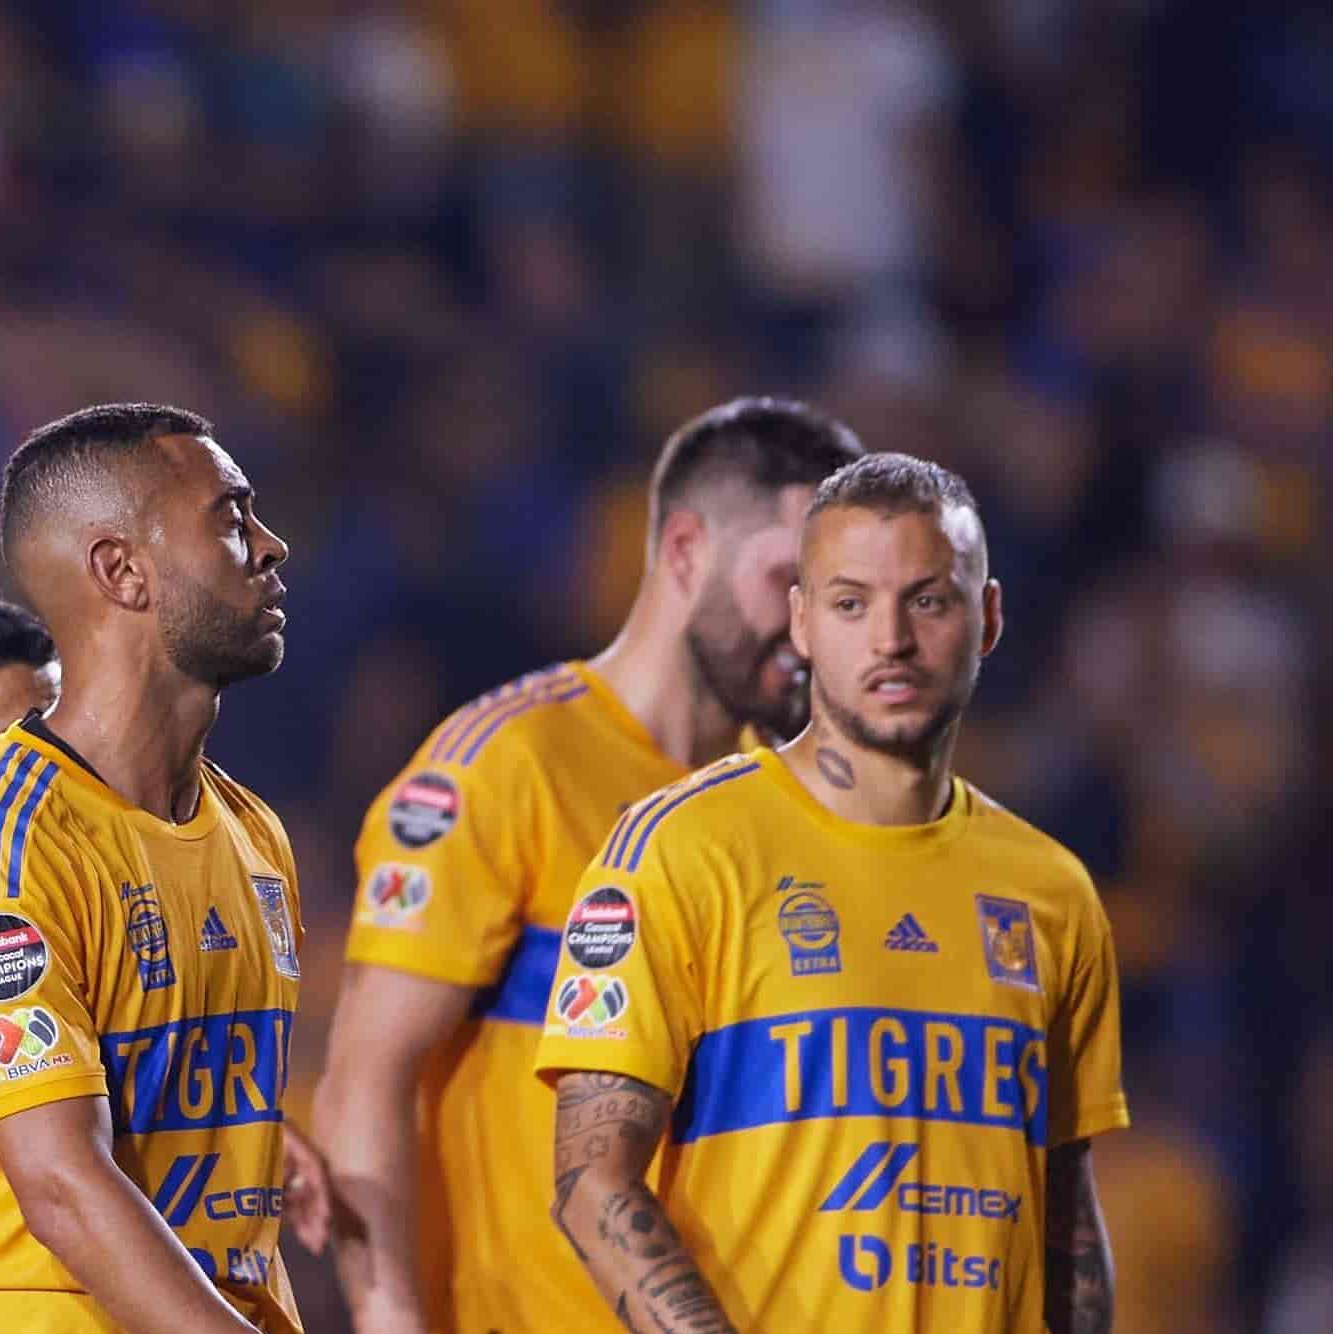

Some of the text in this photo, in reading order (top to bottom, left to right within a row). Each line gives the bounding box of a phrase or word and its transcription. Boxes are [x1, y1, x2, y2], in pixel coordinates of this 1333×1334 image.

[7, 1058, 50, 1079] BBVA
[770, 1016, 1046, 1120] TIGRES
[898, 1182, 1022, 1224] CEMEX
